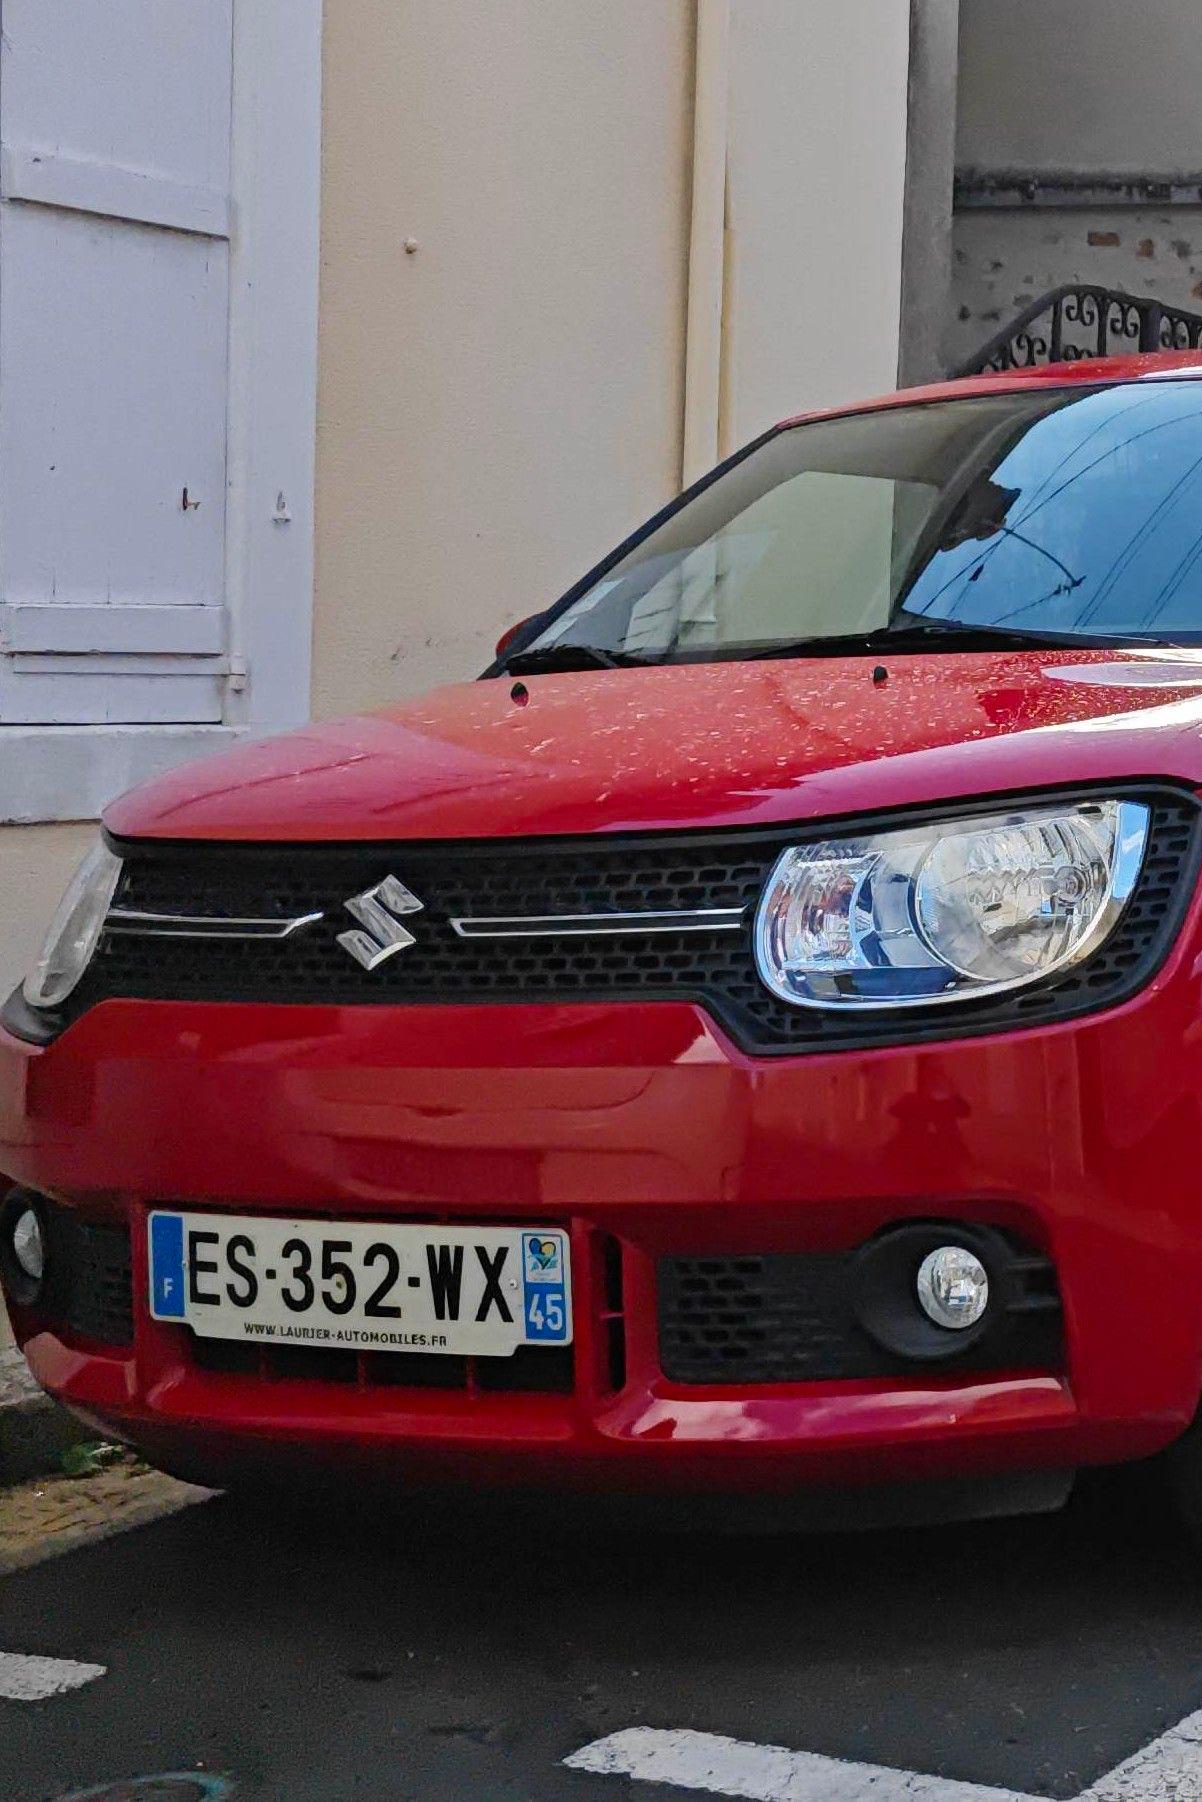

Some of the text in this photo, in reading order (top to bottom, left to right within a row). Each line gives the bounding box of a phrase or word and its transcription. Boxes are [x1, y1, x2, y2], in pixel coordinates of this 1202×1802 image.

[163, 1278, 173, 1299] F
[188, 1229, 514, 1323] ES-352-WX
[528, 1293, 563, 1331] 45
[243, 1322, 447, 1347] WWW.LAURIER-AUTOMOBILES.FR
